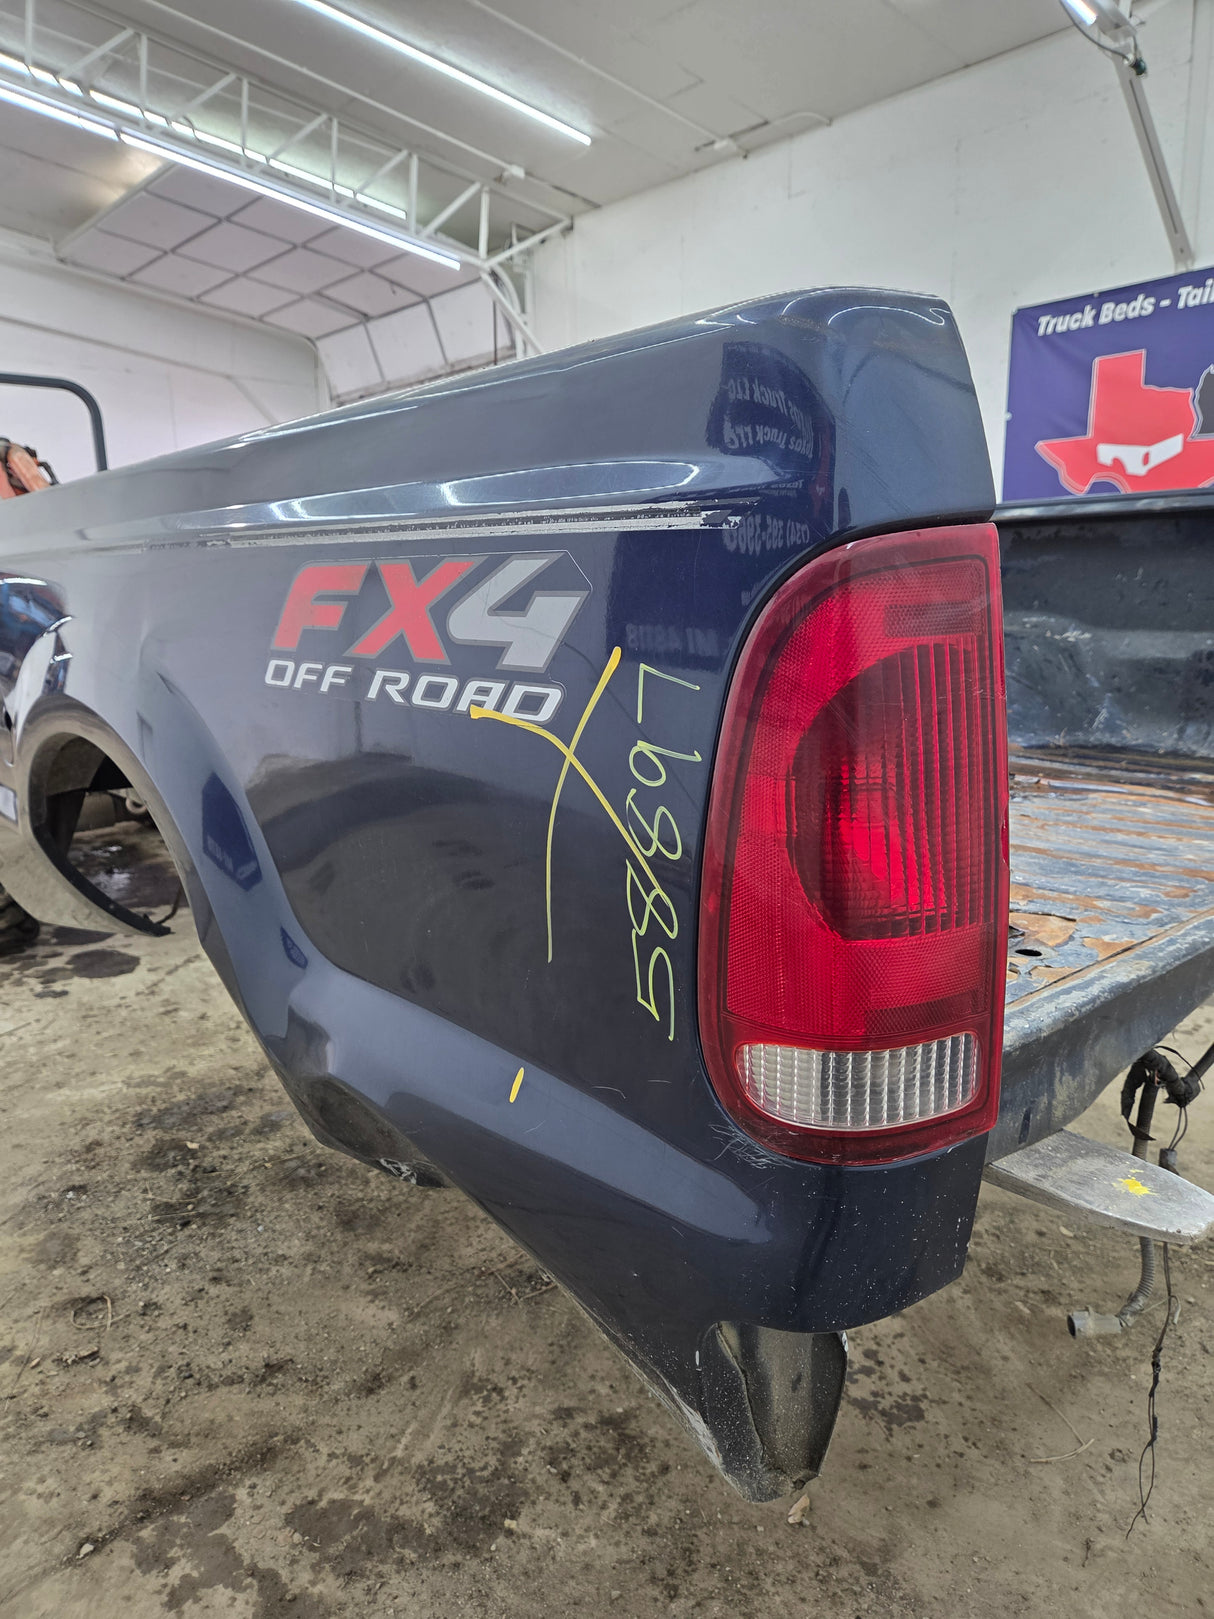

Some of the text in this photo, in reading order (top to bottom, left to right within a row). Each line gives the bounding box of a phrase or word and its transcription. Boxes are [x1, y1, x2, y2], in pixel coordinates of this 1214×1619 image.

[1037, 303, 1097, 337] Truck
[1098, 293, 1156, 325] Beds
[270, 552, 589, 673] FX4
[264, 658, 563, 722] OFF ROAD
